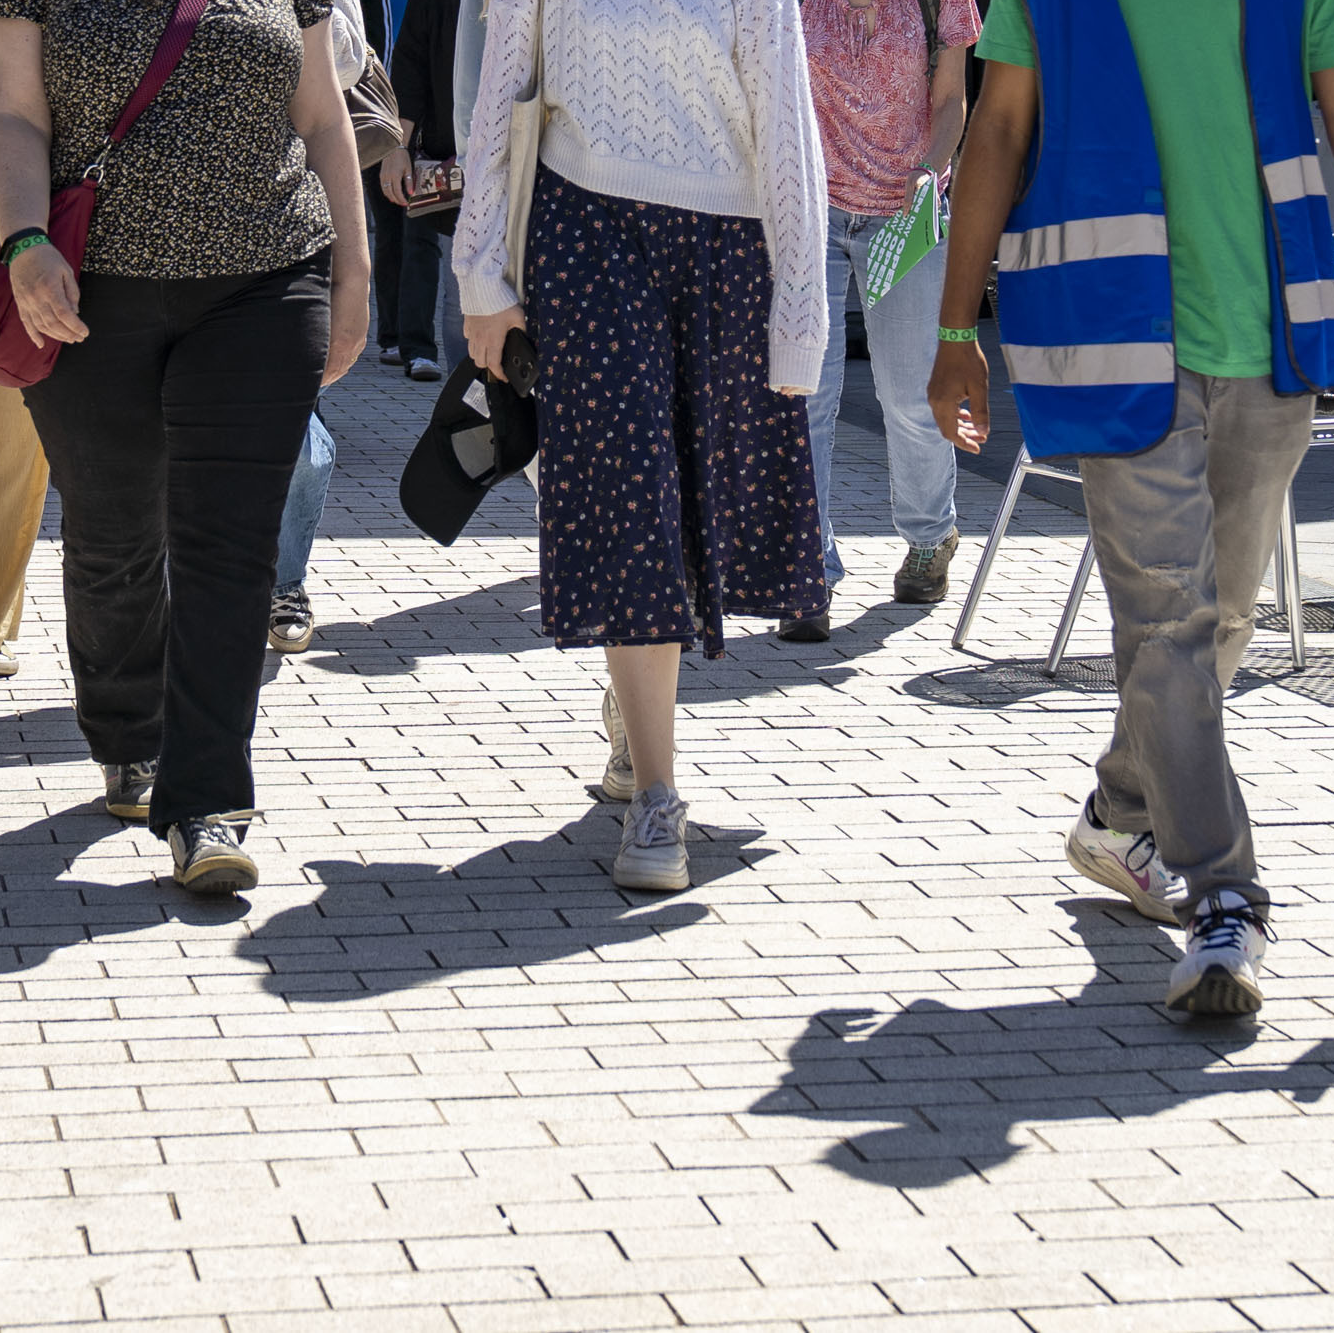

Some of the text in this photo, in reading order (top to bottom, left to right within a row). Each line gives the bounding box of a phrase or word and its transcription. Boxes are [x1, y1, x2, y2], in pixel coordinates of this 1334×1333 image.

[891, 209, 903, 231] DAY
[902, 216, 916, 238] DAY
[871, 235, 899, 294] OPEN
